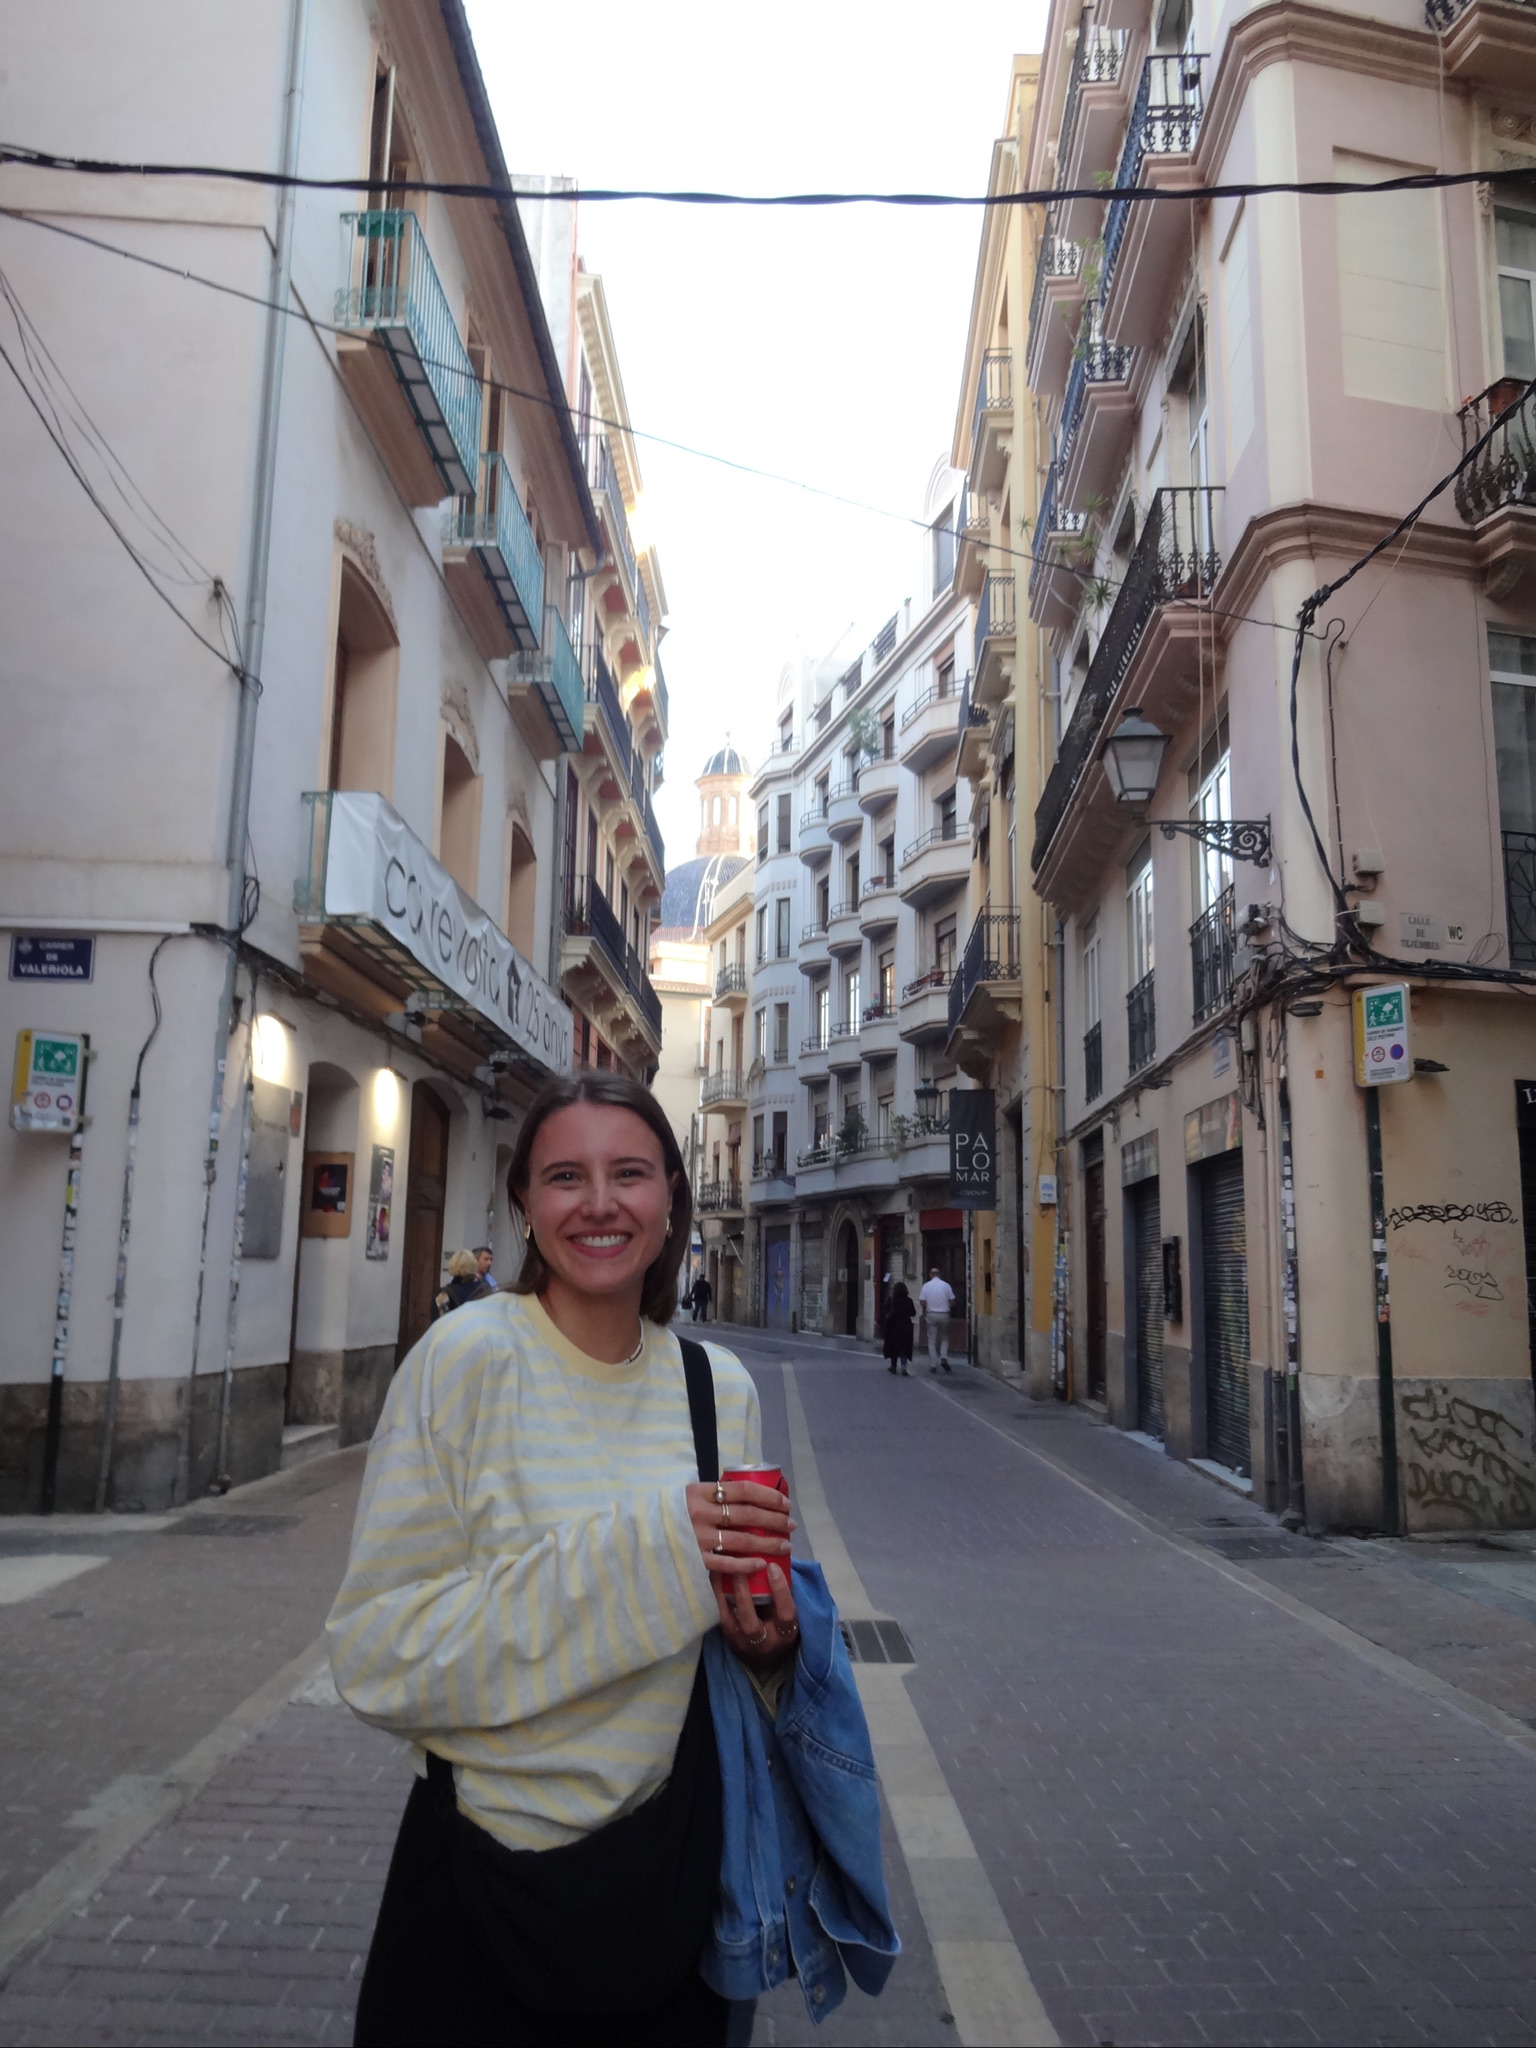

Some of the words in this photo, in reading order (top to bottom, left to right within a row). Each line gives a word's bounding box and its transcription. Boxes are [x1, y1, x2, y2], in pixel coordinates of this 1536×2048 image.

[1416, 928, 1426, 938] DE
[1447, 925, 1463, 941] WC
[19, 963, 84, 977] VALERIOLA
[955, 1151, 990, 1170] LO
[955, 1171, 990, 1182] MAR
